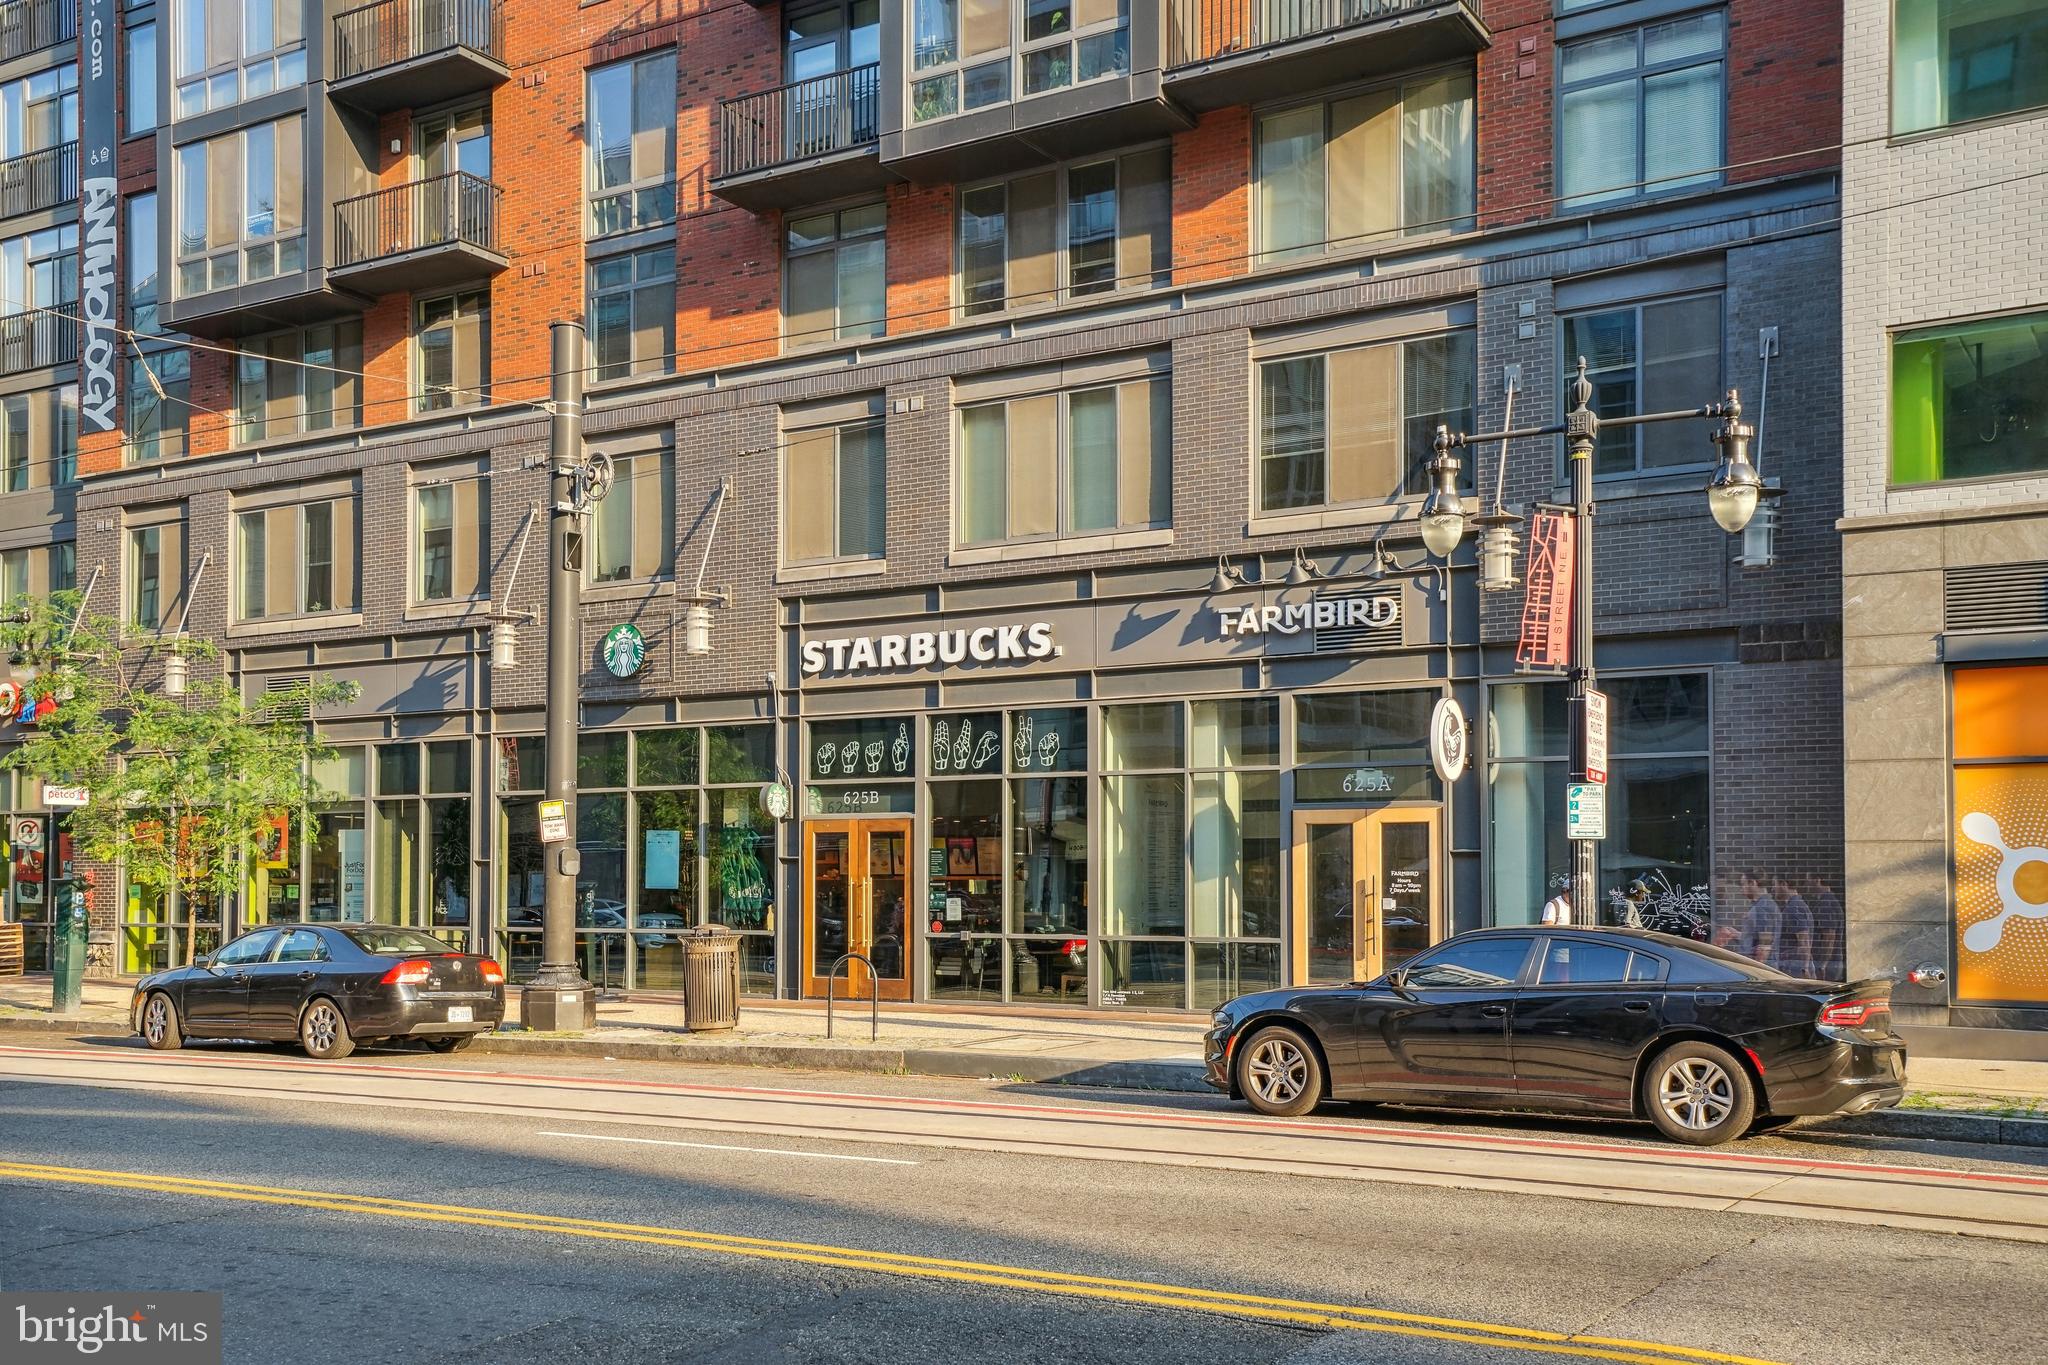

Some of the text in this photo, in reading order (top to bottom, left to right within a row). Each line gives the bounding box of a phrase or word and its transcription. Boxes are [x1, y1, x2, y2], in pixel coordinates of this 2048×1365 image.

[83, 178, 118, 431] ANTHOLOGY
[1554, 581, 1565, 634] STREET
[1218, 597, 1398, 635] FARMBIRD
[1553, 643, 1561, 651] H
[1343, 777, 1392, 792] 625A
[48, 790, 75, 799] petco
[843, 791, 879, 804] 625B
